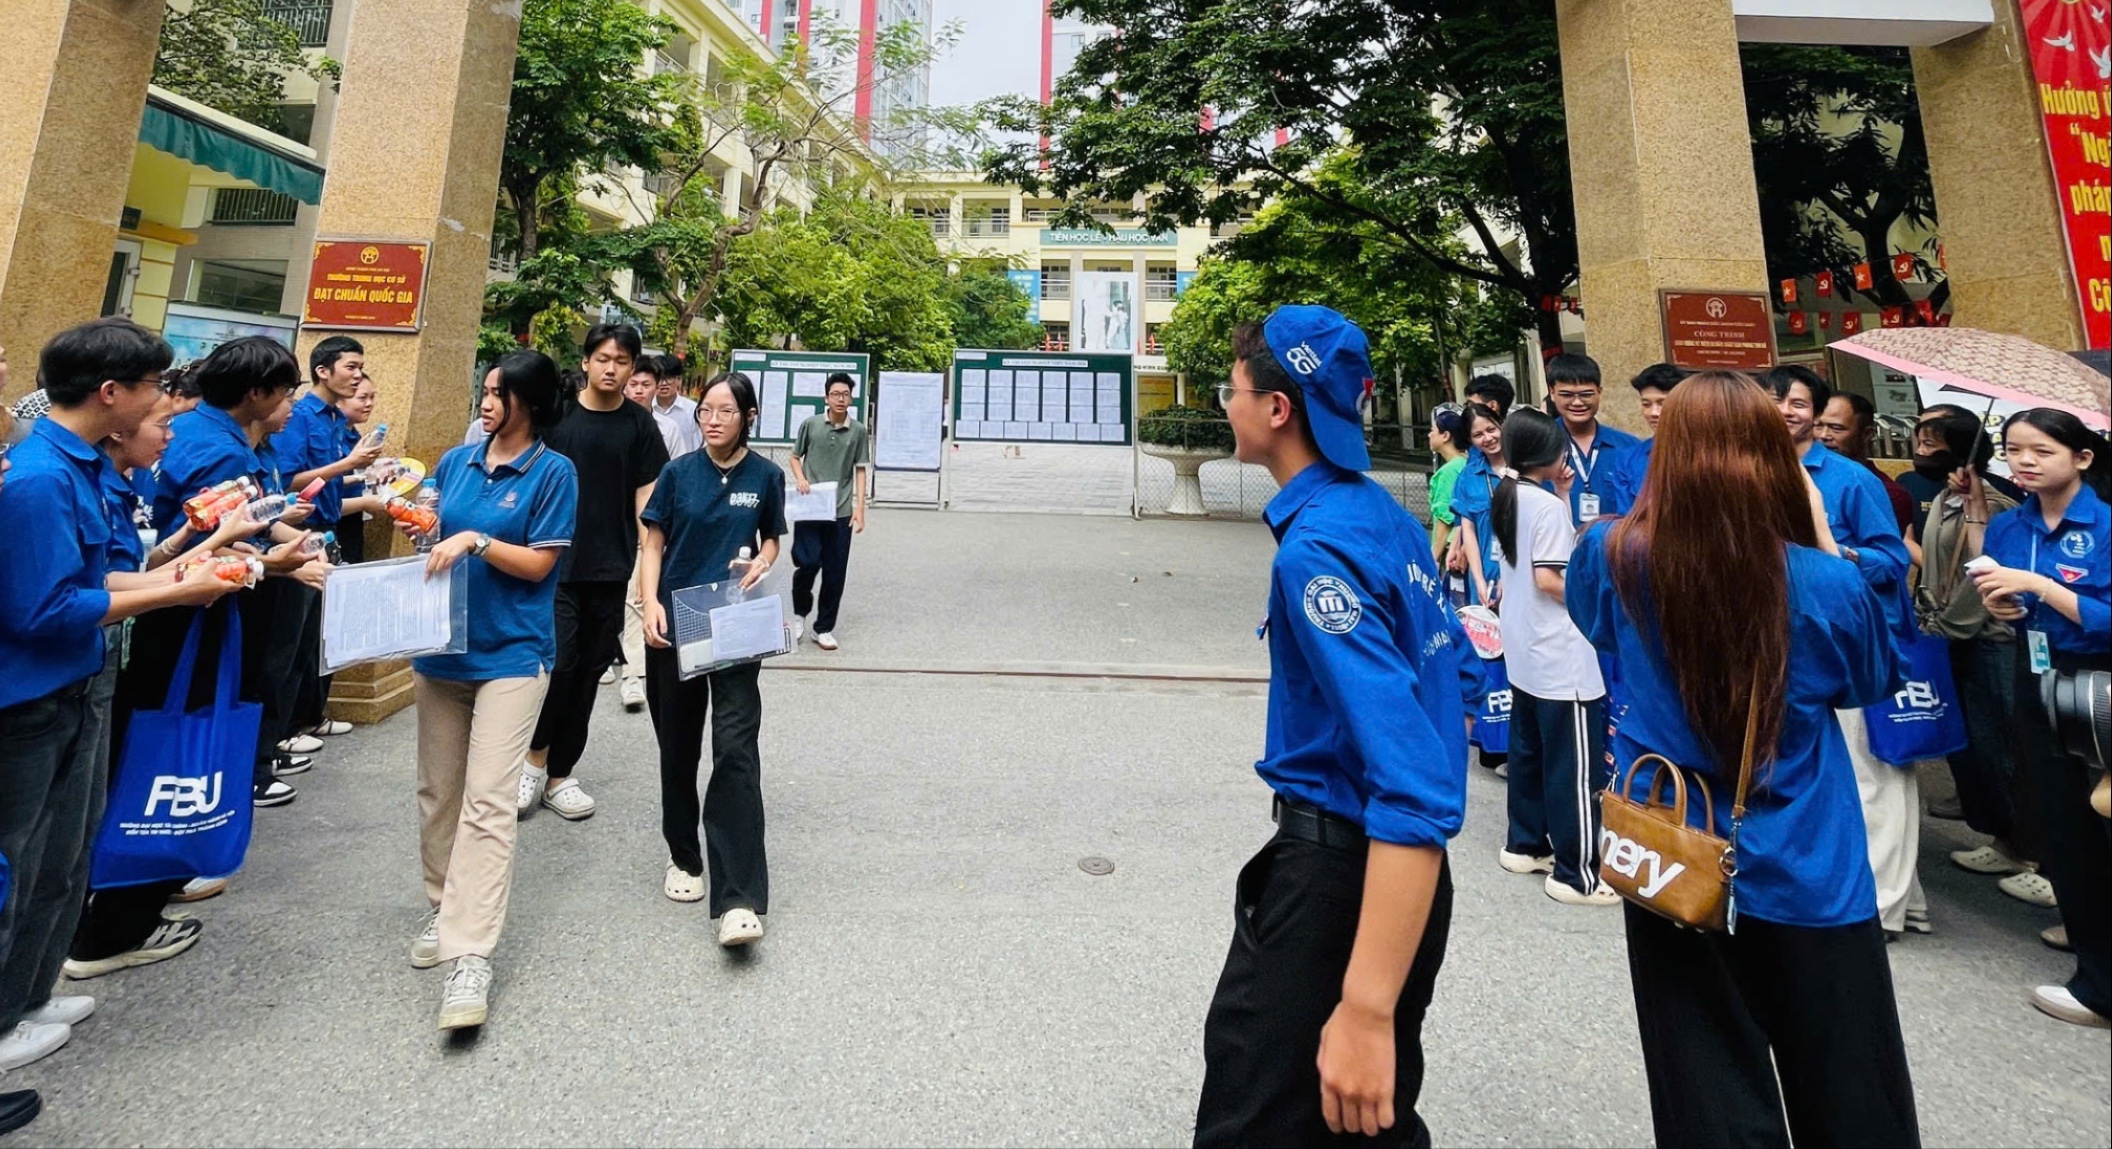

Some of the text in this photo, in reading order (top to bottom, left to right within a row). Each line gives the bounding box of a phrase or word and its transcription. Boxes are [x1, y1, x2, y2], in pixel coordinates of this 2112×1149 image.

[2040, 80, 2101, 120] Hưởng
[1071, 233, 1089, 244] HỌC
[1130, 233, 1149, 244] HỌC
[313, 287, 333, 303] ĐẠT
[369, 286, 395, 303] QUỐC
[396, 291, 413, 304] GIA
[1286, 347, 1317, 375] 5G
[144, 771, 222, 816] FBU
